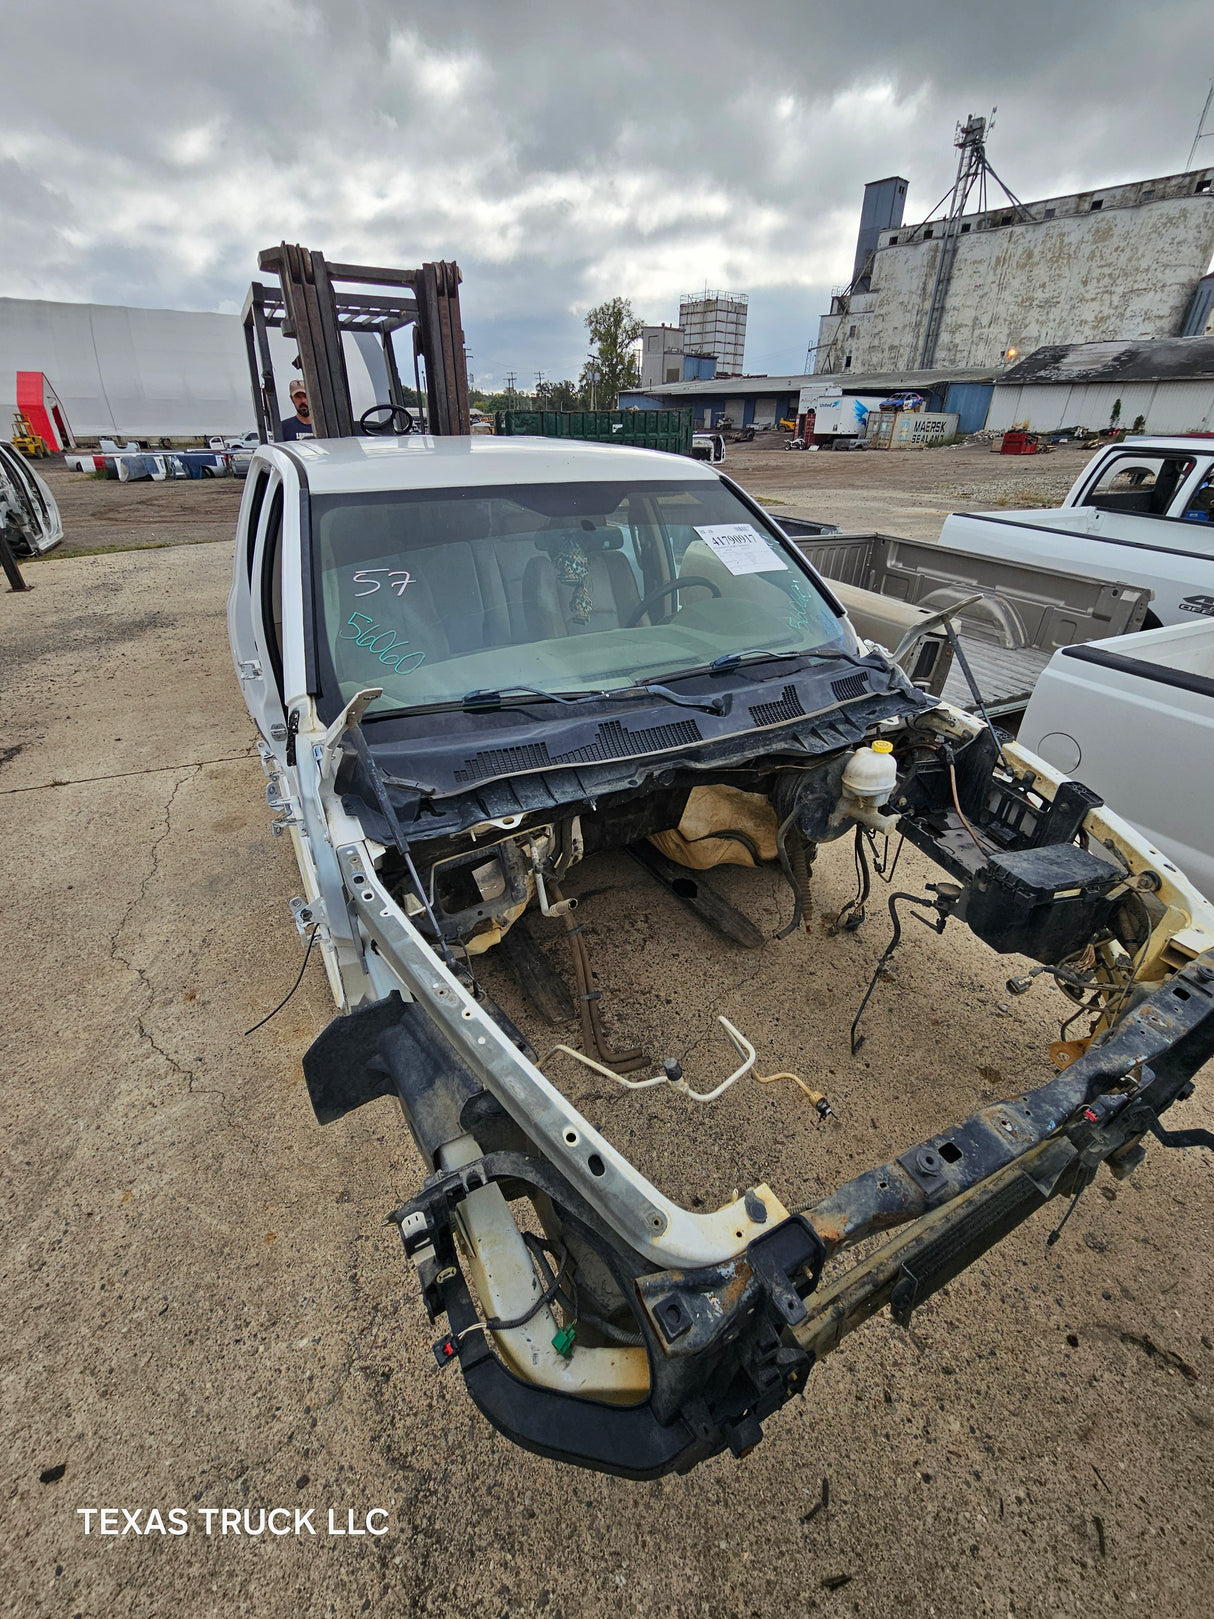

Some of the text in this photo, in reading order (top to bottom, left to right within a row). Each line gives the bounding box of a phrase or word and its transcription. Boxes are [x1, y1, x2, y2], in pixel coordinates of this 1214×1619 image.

[913, 420, 947, 433] MAERSK
[712, 534, 758, 546] 41790917
[353, 568, 417, 597] 57
[339, 611, 426, 675] 56060
